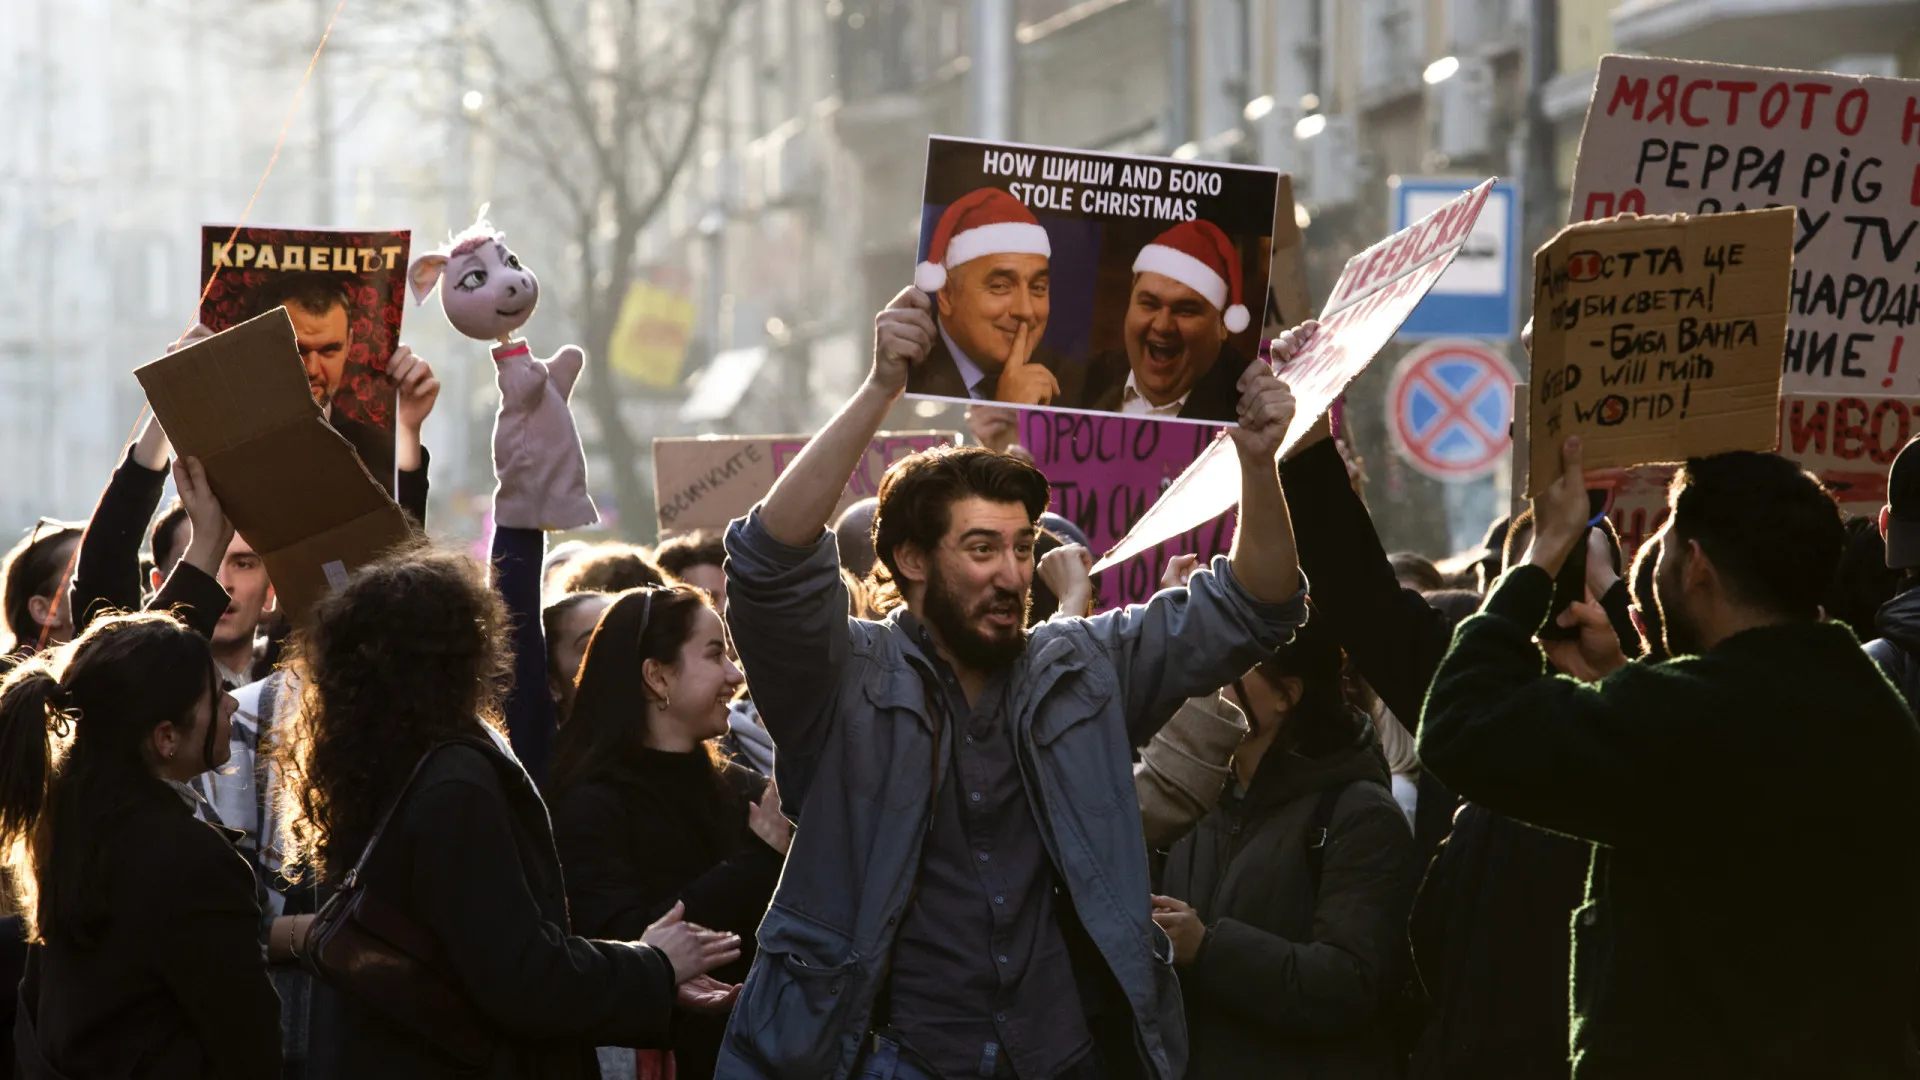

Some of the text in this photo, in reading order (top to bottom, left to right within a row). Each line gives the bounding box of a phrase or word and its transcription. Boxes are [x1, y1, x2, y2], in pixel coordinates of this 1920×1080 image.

[1606, 74, 1870, 136] МЯСТОТО
[983, 150, 1223, 197] HOW ШИШИ AND БОКО
[1635, 138, 1786, 196] PEPPA
[1008, 181, 1198, 222] STOLE CHRISTMAS
